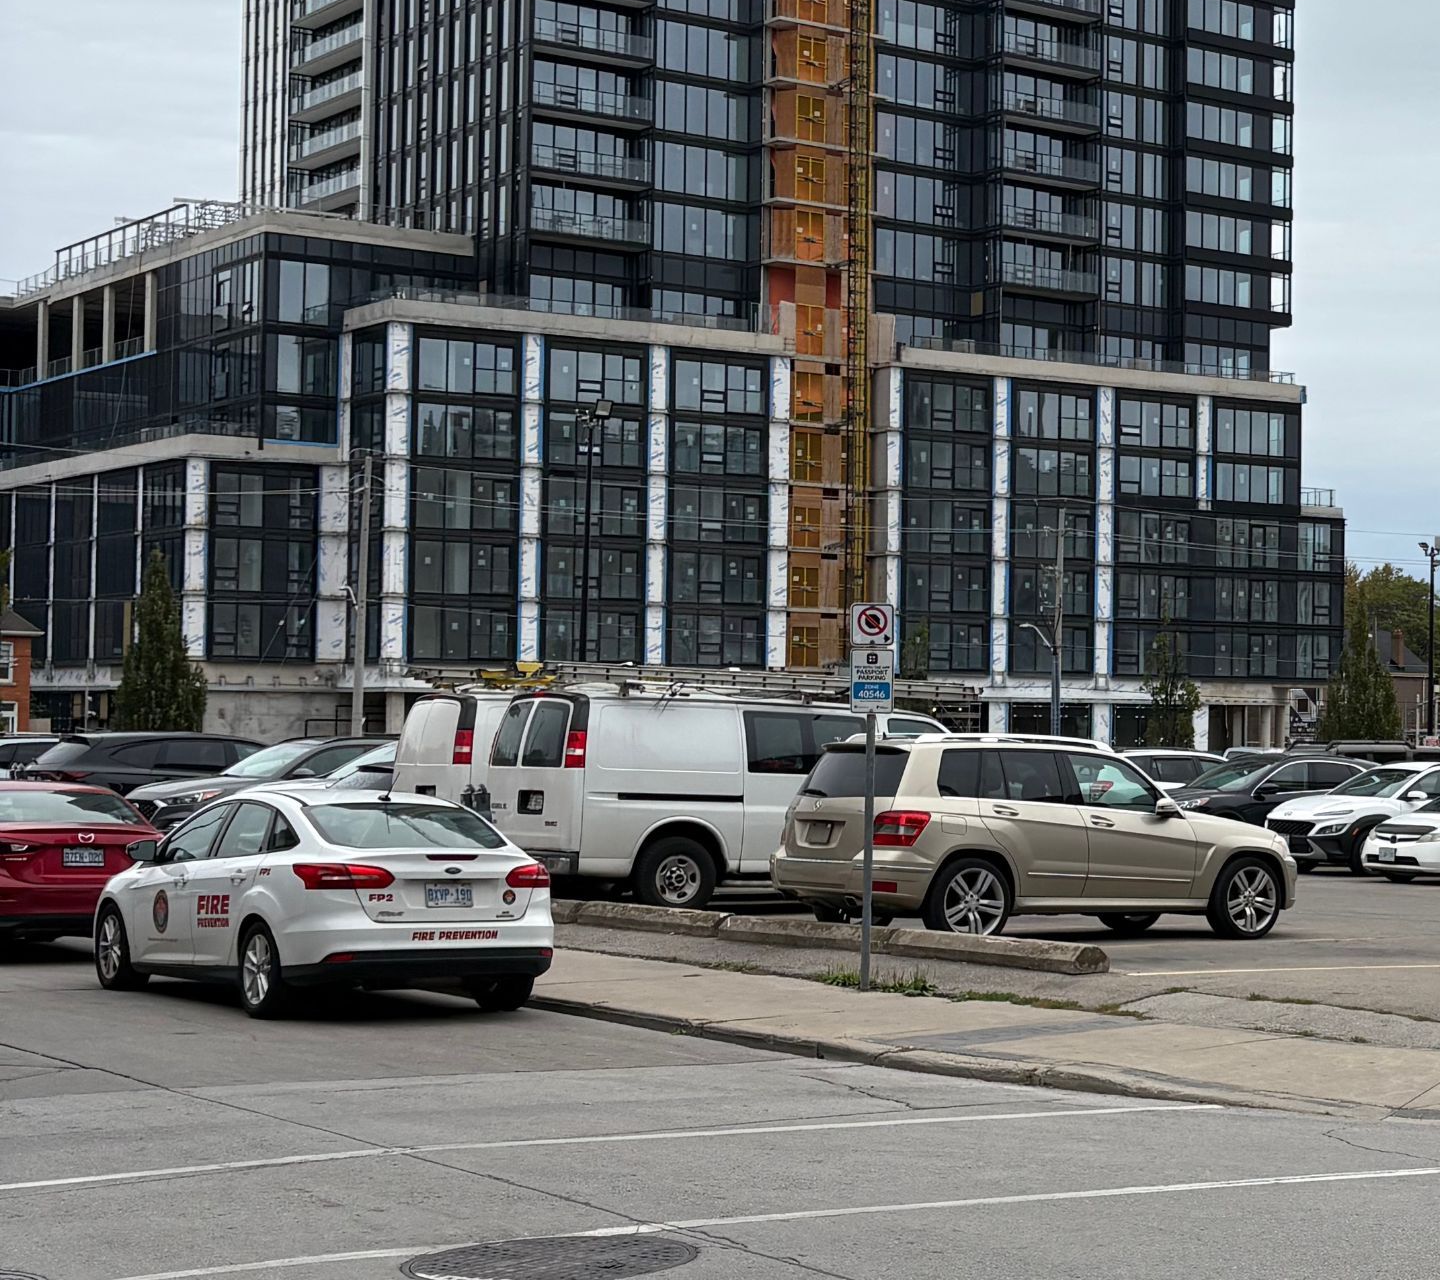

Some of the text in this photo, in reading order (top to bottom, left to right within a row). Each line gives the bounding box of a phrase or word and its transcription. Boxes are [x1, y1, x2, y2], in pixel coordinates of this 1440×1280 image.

[858, 690, 886, 698] 40546
[368, 893, 393, 902] FP2
[197, 895, 230, 915] FIRE
[197, 917, 229, 928] PREVENTION
[412, 930, 498, 941] FIRE PREVENTION
